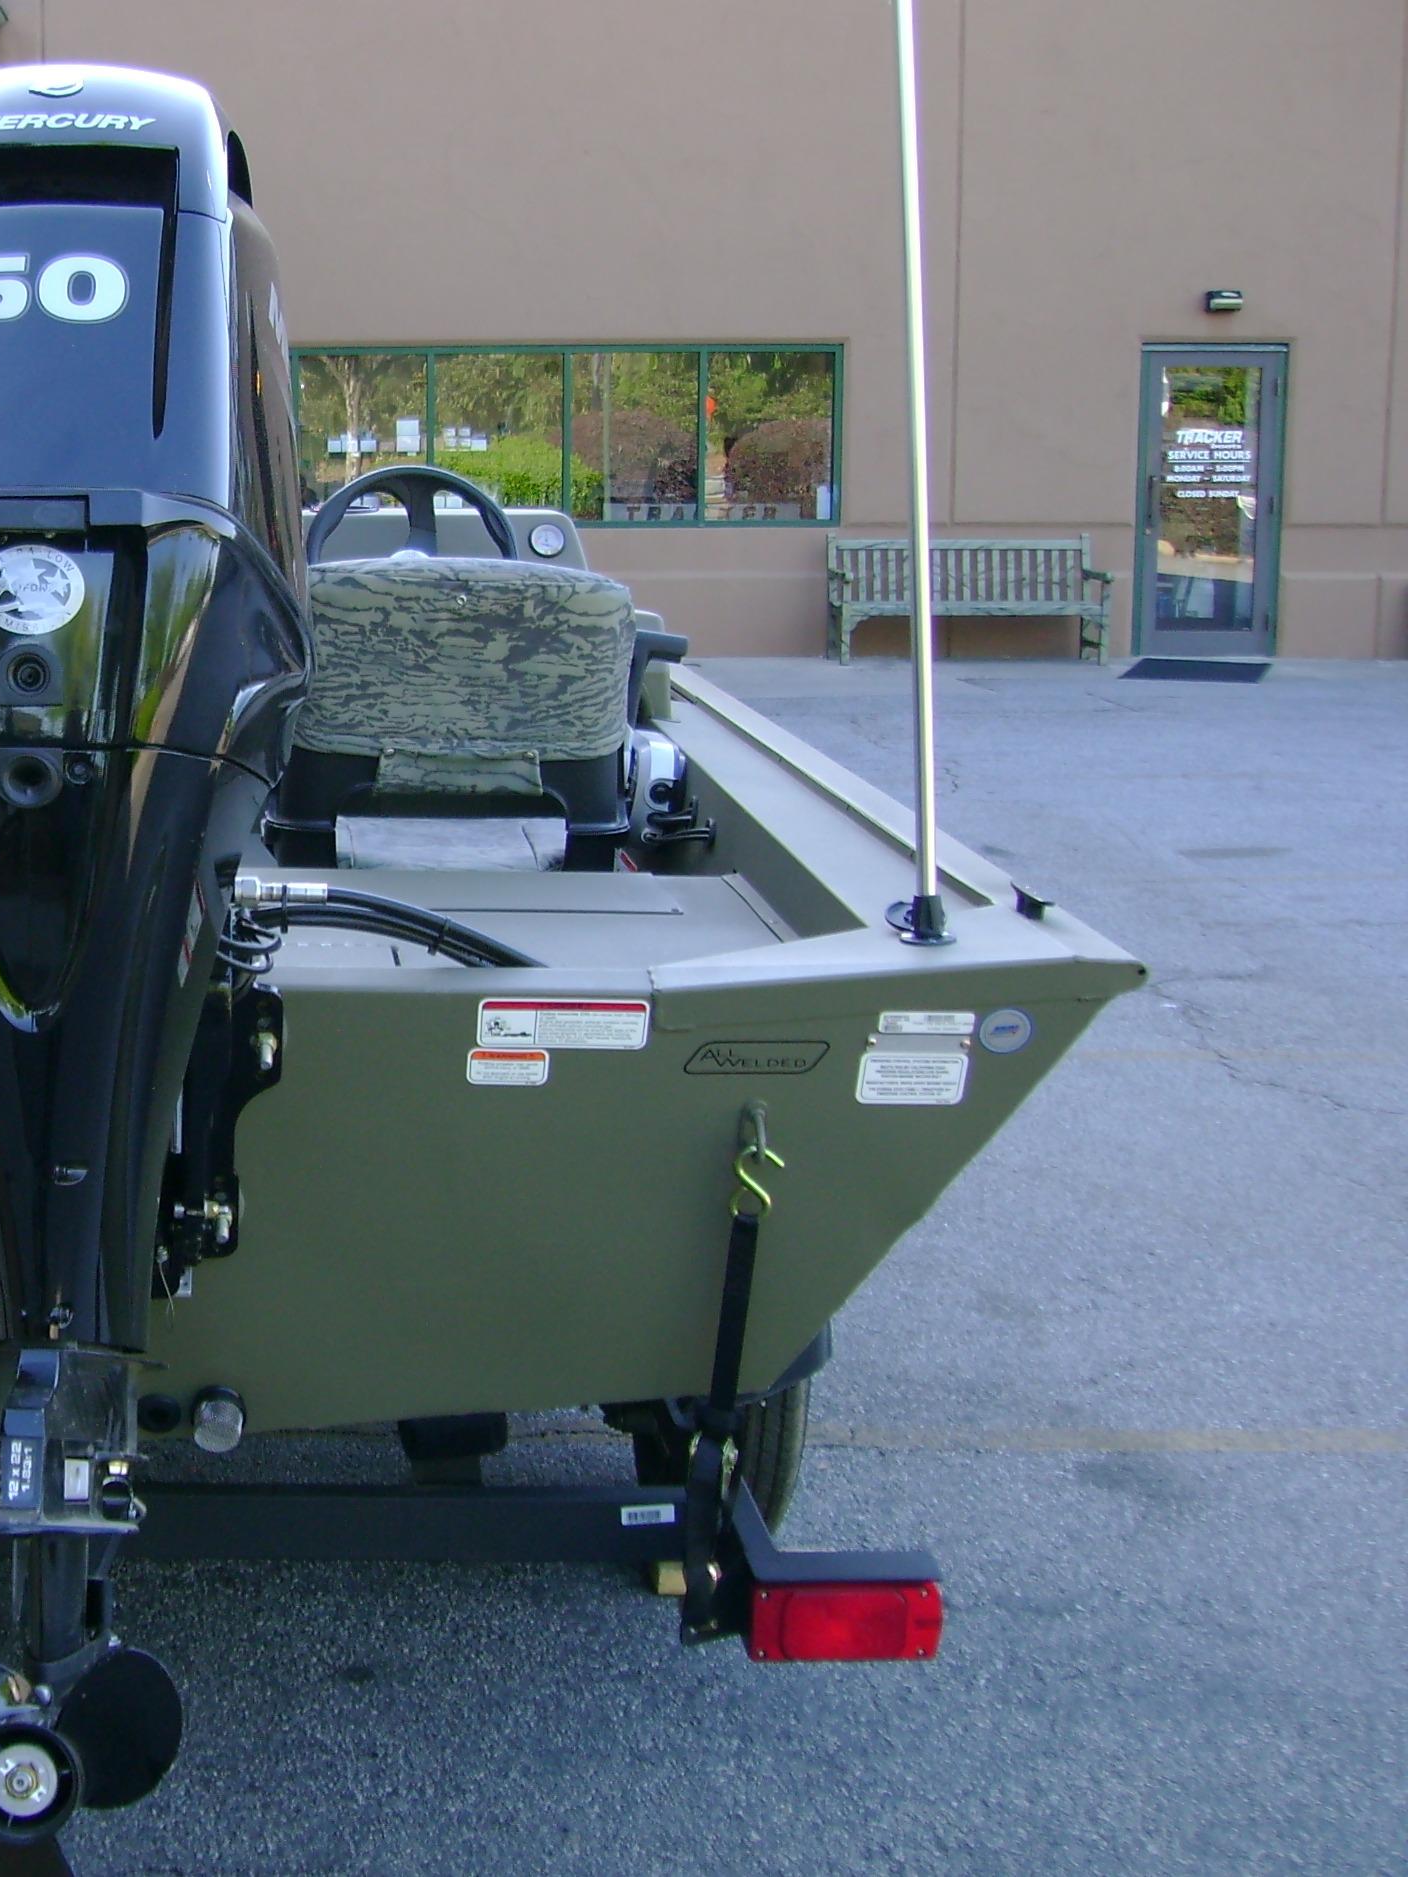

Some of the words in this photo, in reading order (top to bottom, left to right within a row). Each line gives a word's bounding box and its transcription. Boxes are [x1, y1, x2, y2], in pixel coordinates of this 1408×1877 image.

[1176, 430, 1244, 443] TRACKER
[1168, 450, 1210, 459] SERVICE
[1214, 450, 1252, 459] HOURS
[626, 506, 777, 520] TRAER
[10, 1440, 22, 1465] 22
[8, 1481, 19, 1501] 12
